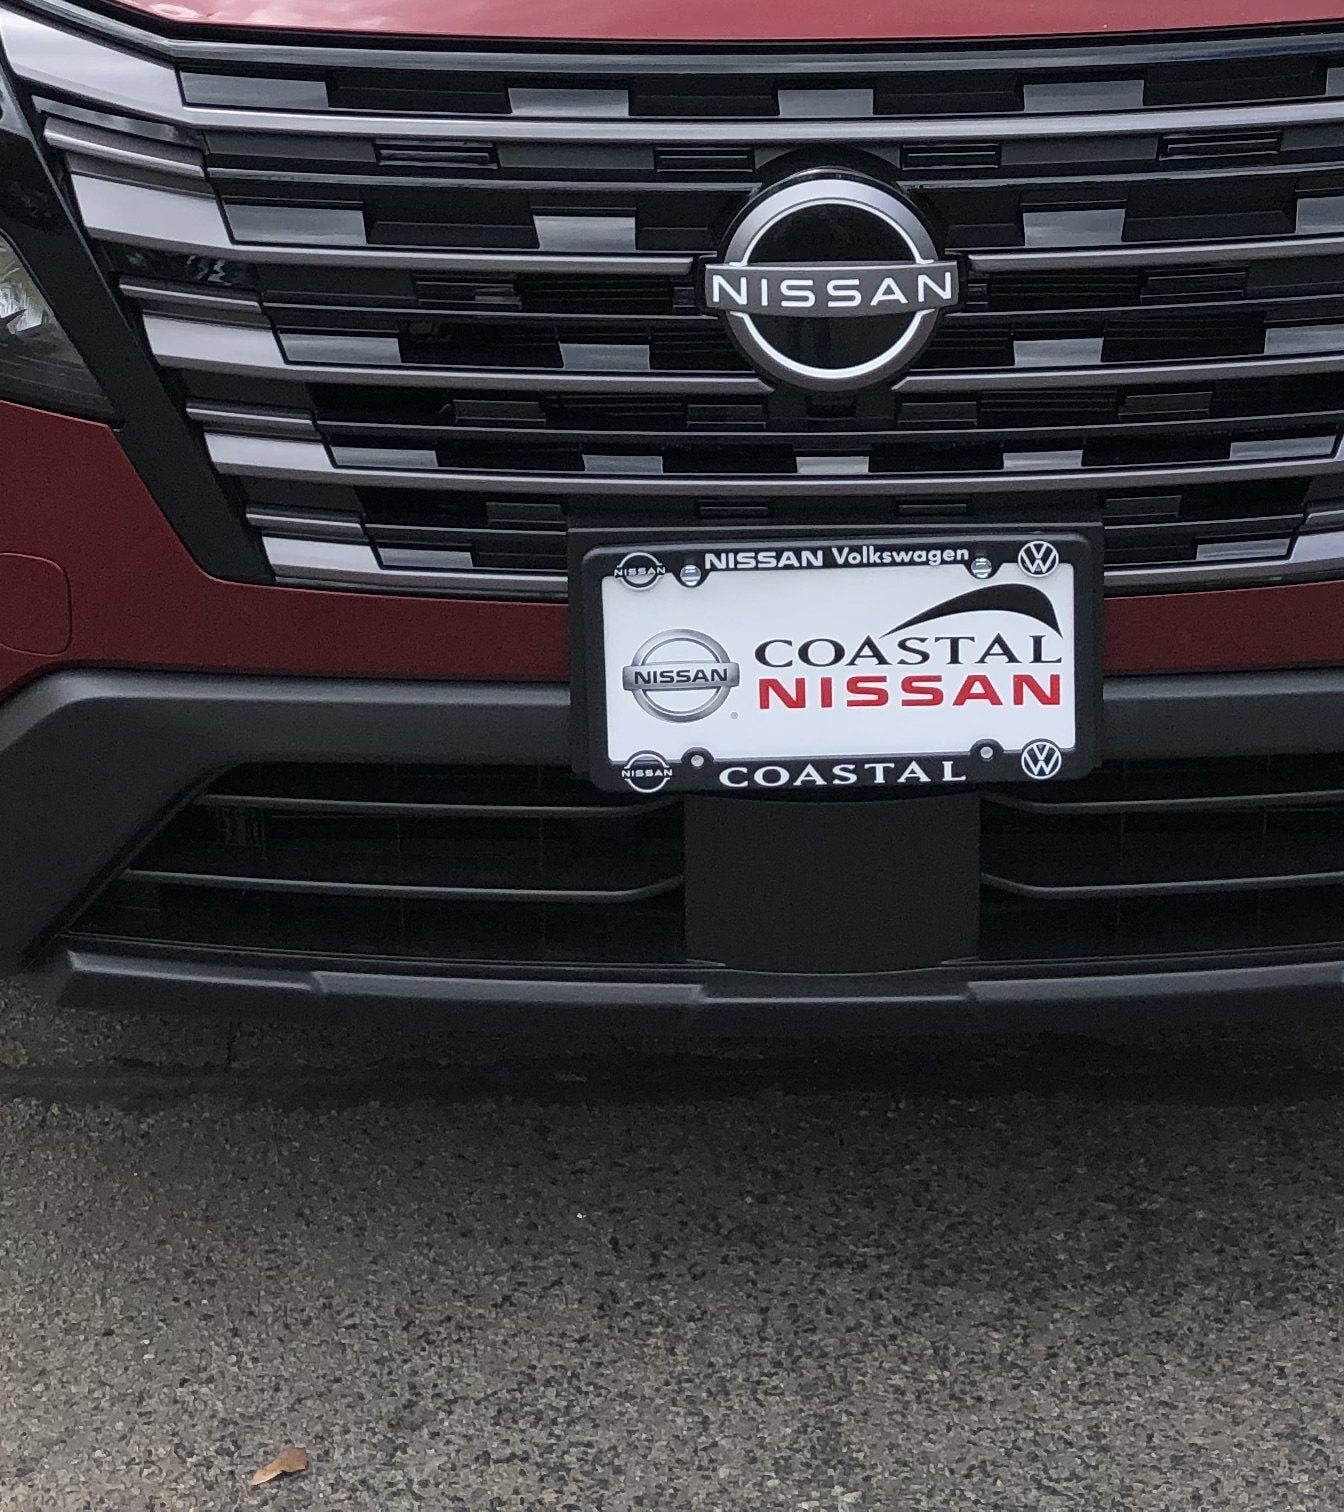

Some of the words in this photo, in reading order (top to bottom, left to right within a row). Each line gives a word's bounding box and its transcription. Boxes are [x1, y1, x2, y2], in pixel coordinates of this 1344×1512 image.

[712, 271, 952, 308] NISSAN
[705, 550, 824, 570] NISSAN
[831, 545, 969, 566] Volkswagen
[614, 566, 666, 577] NISSAN
[754, 633, 1063, 668] COASTAL
[634, 668, 728, 685] NISSAN
[758, 674, 1061, 710] NISSAN
[621, 768, 673, 778] NISSAN
[719, 760, 967, 788] COASTAL
